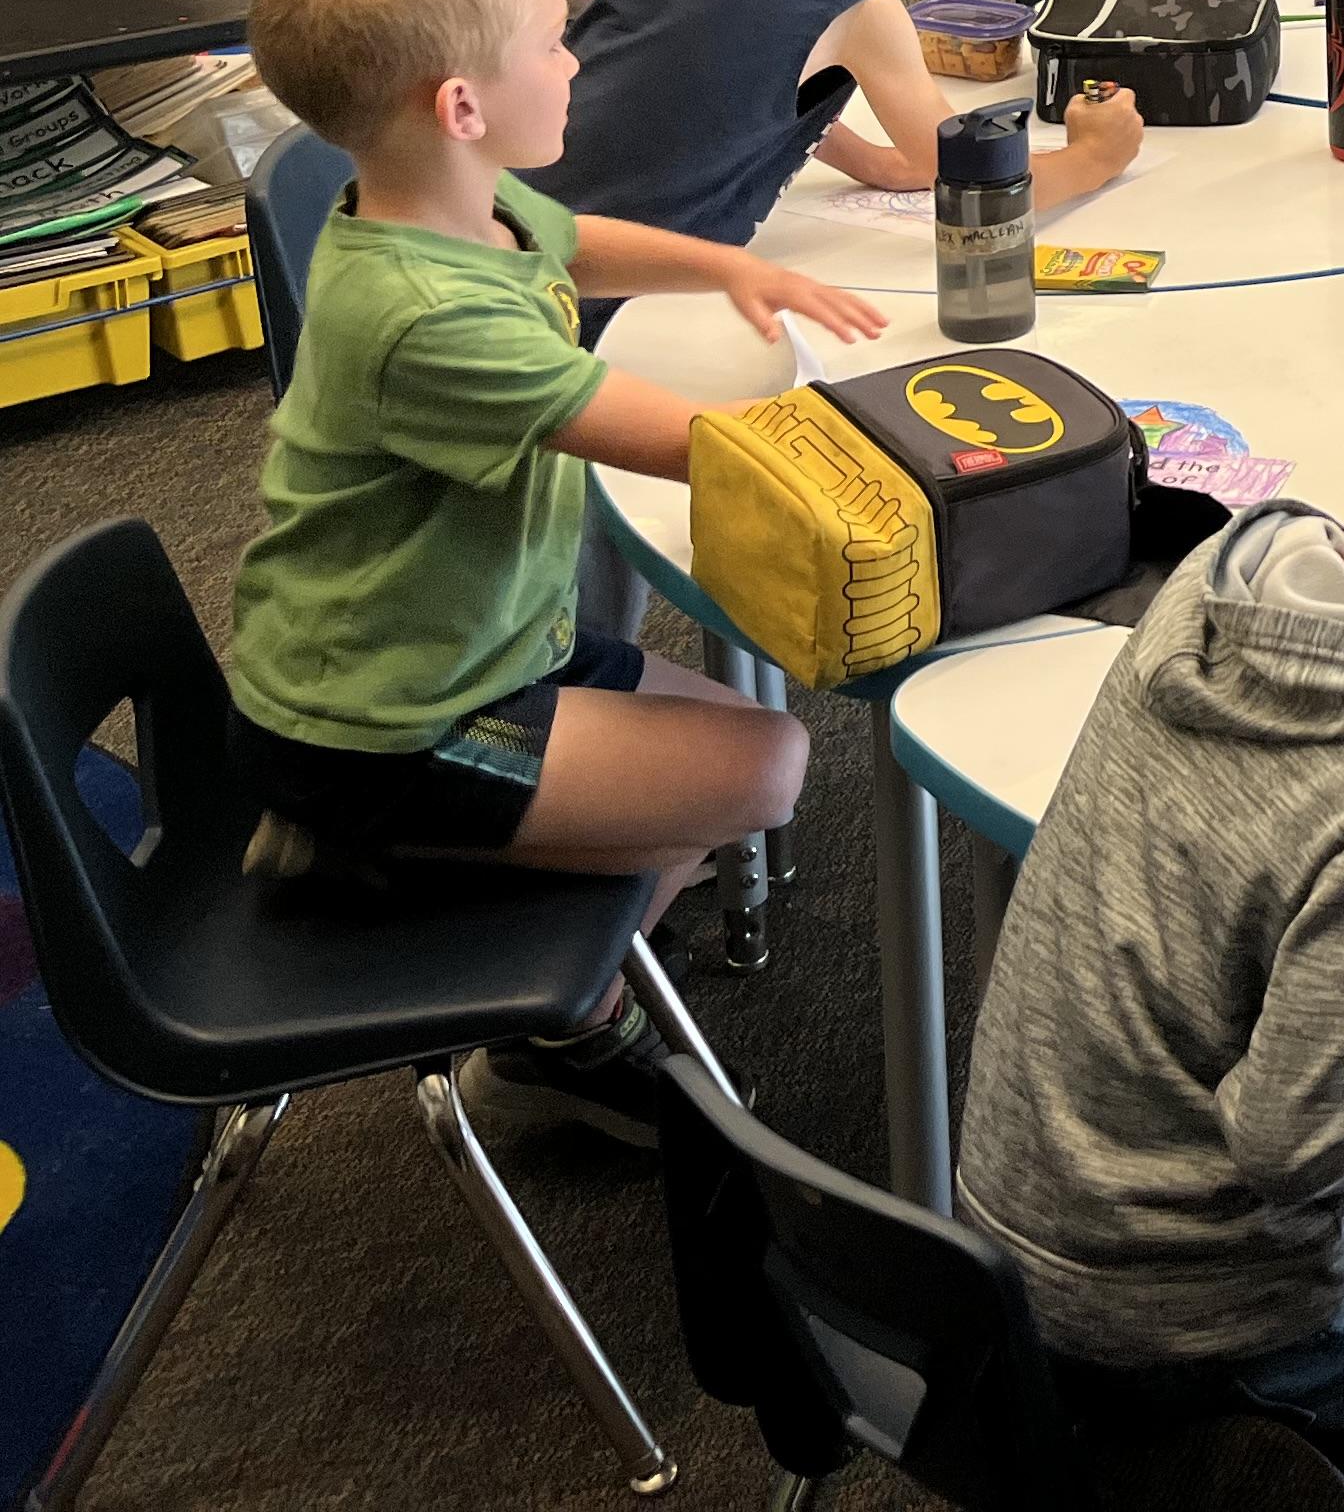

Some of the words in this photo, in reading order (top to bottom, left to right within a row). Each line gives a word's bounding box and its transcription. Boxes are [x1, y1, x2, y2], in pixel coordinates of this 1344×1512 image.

[10, 110, 79, 149] Groups
[0, 157, 74, 190] nack
[1178, 458, 1221, 474] the
[1162, 474, 1198, 486] of
